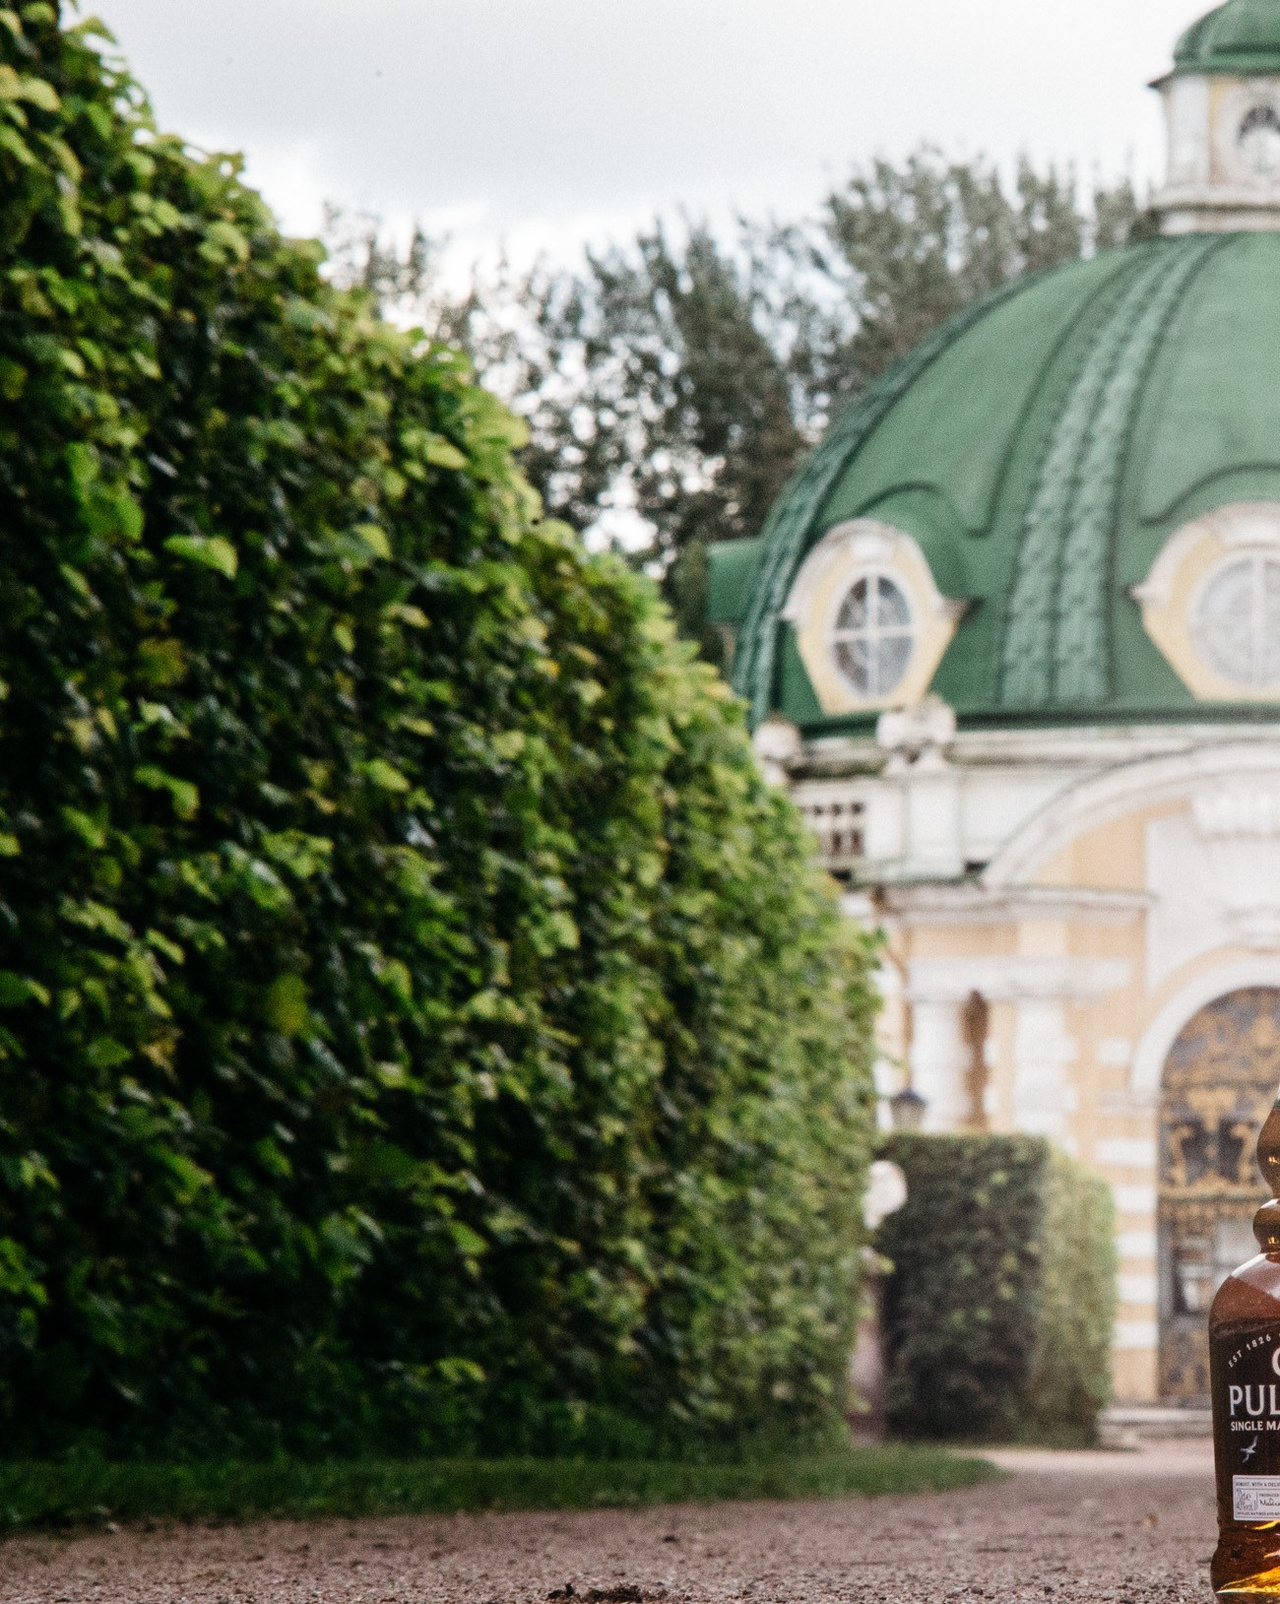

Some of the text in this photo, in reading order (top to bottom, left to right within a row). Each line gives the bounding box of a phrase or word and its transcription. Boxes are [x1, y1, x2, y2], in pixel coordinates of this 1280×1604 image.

[1228, 1350, 1243, 1368] EST
[1245, 1334, 1272, 1350] 1826
[1230, 1420, 1264, 1431] SINGLE
